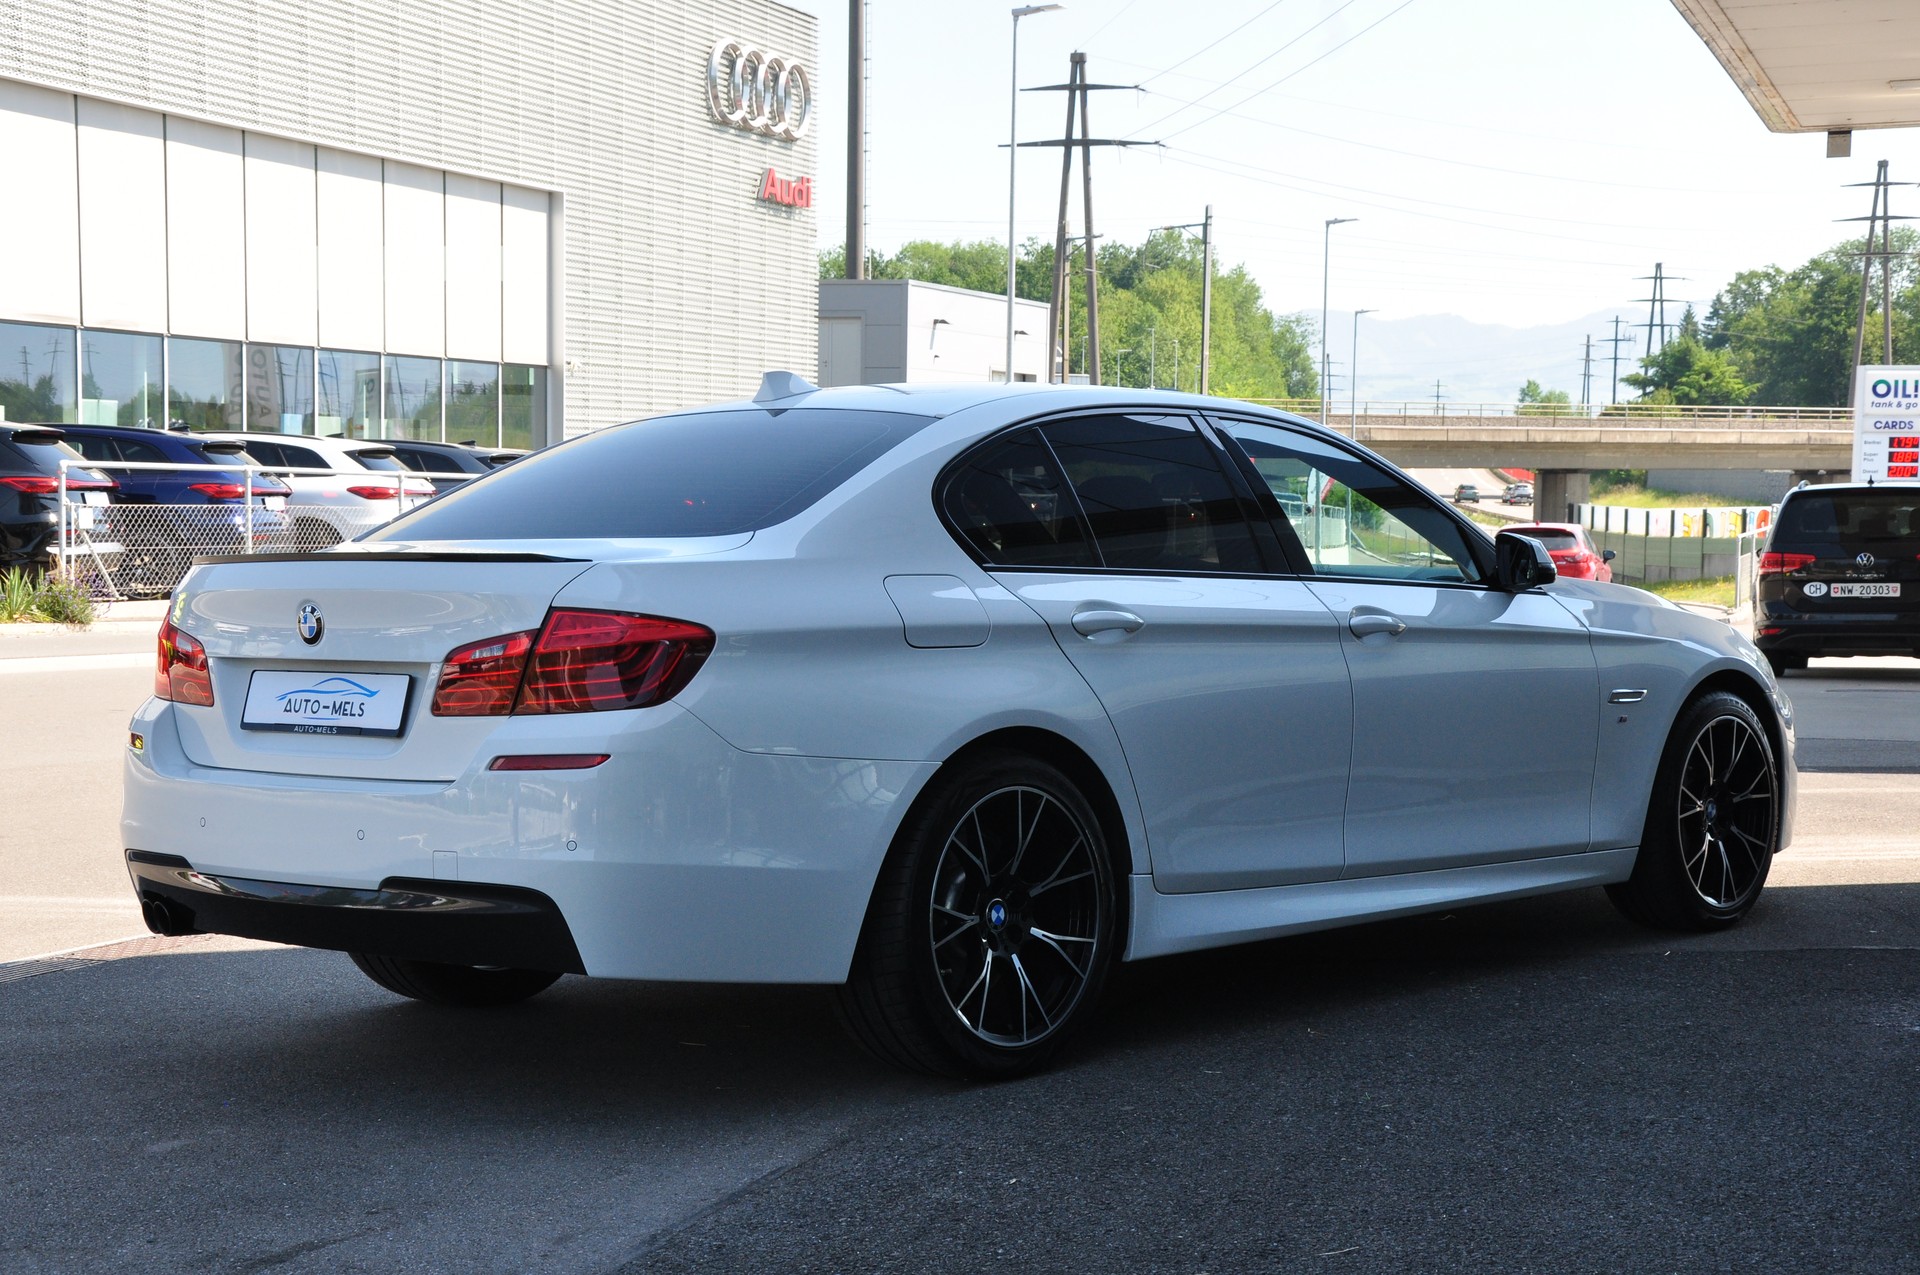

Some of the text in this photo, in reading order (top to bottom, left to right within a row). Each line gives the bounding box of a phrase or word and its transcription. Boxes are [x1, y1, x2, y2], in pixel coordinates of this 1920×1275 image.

[762, 168, 812, 208] Audi
[1872, 379, 1919, 398] OIL!
[1905, 402, 1918, 410] go
[1874, 421, 1914, 429] CARDS
[1808, 584, 1822, 594] CH
[1840, 585, 1890, 595] NW 20303
[293, 725, 337, 734] AUTO-MELS
